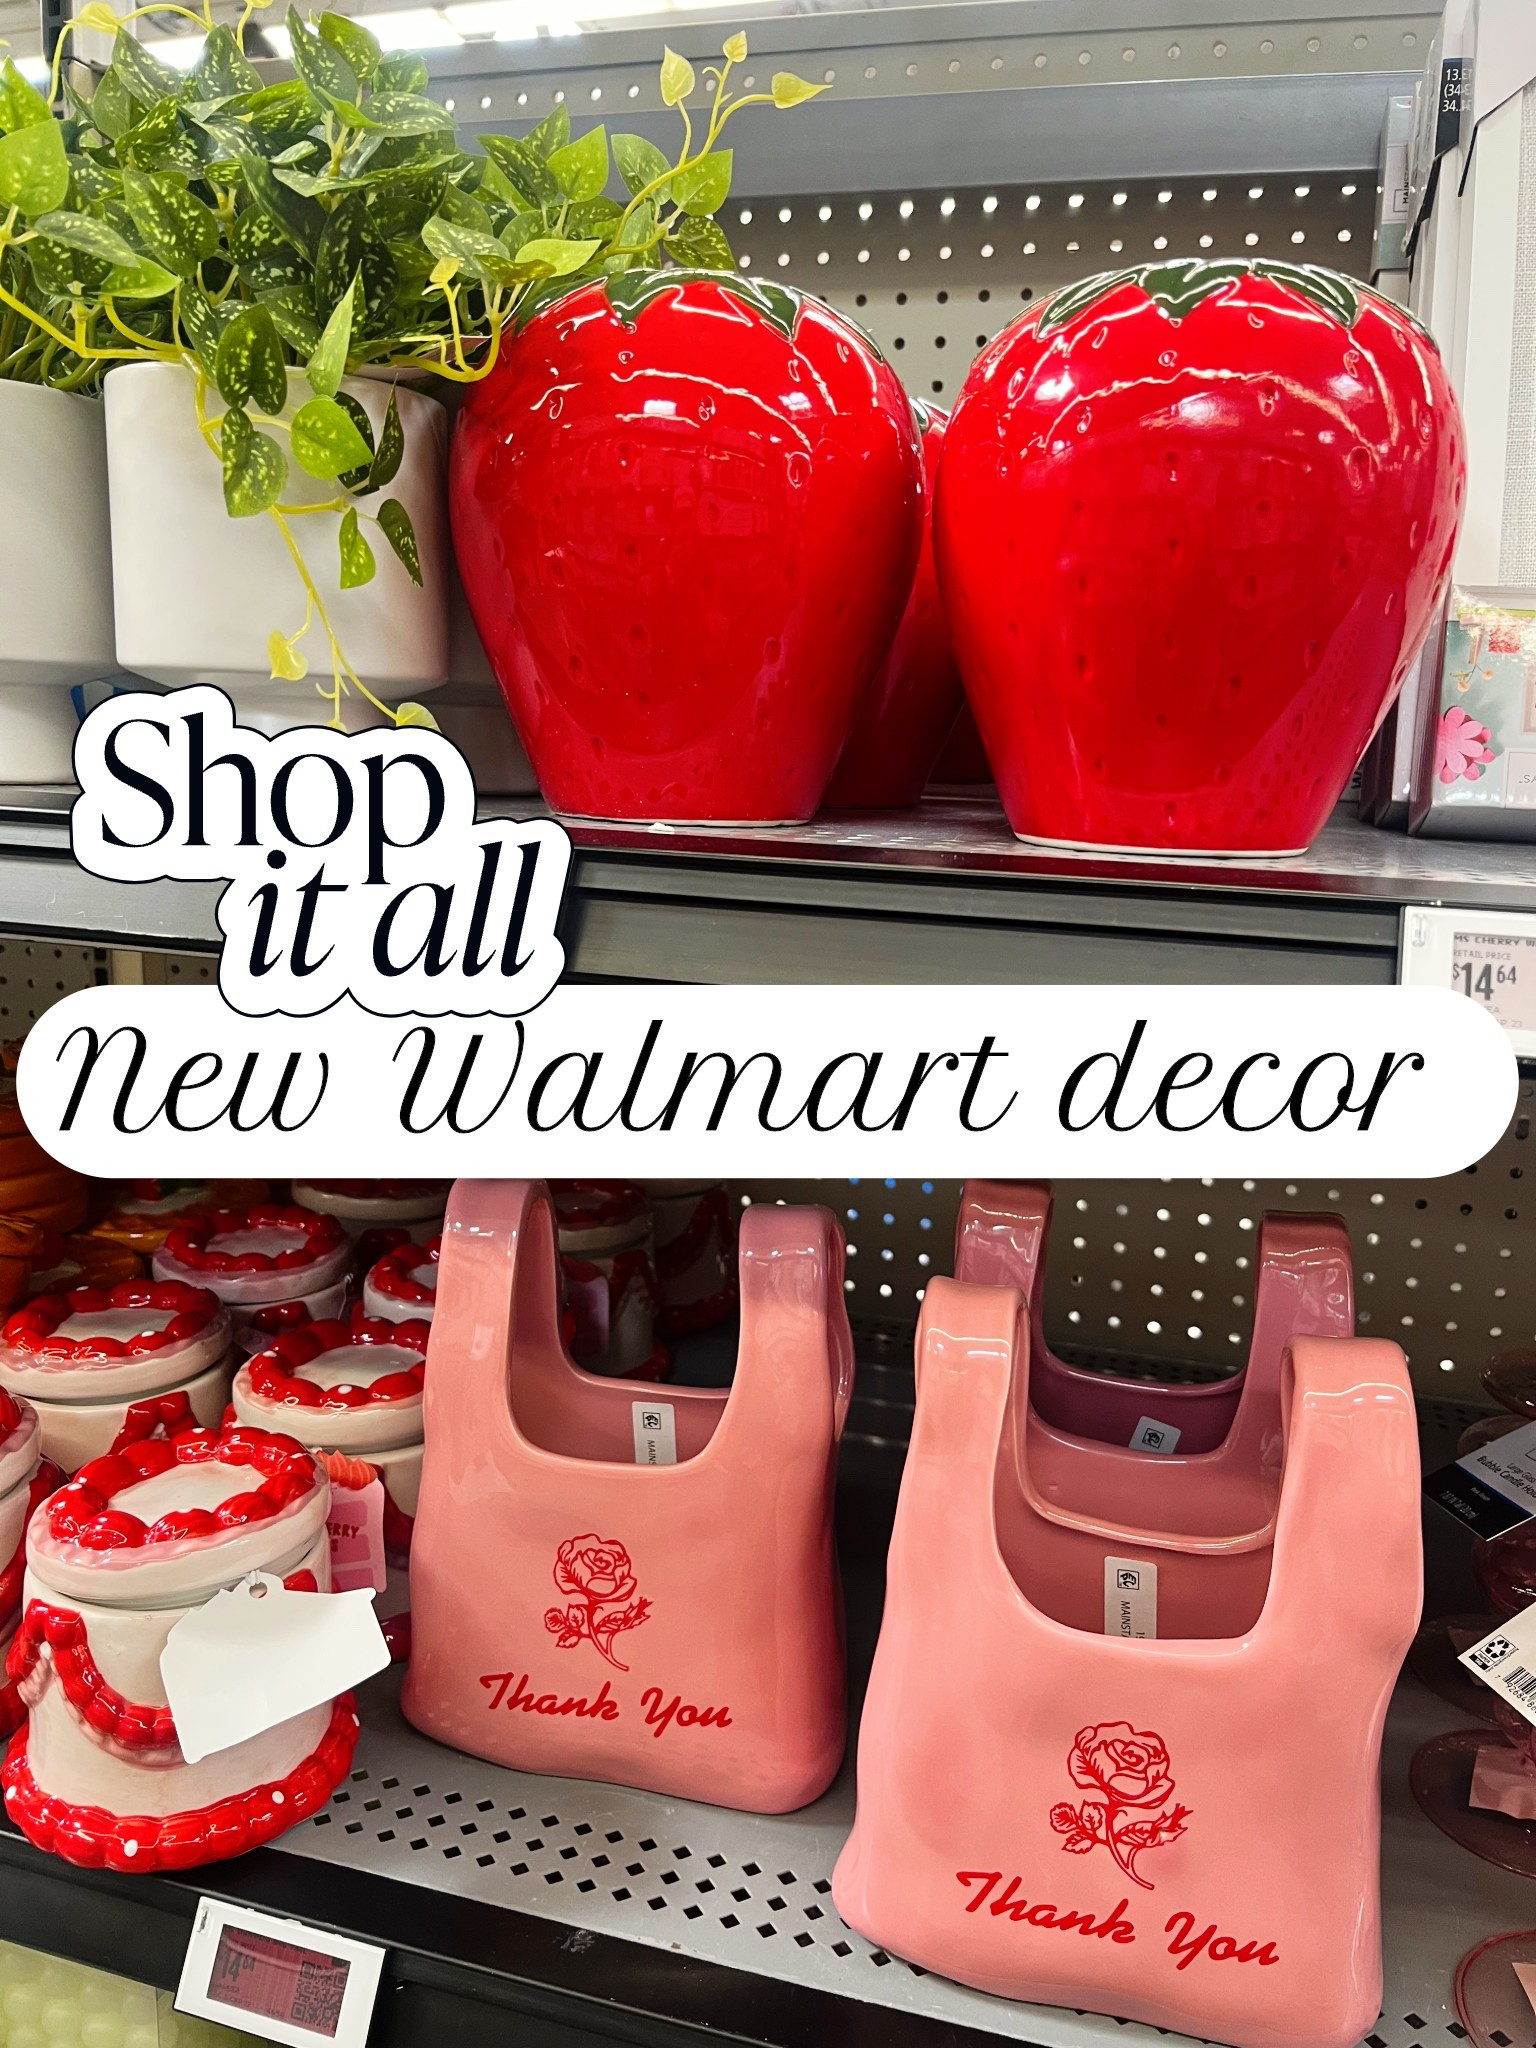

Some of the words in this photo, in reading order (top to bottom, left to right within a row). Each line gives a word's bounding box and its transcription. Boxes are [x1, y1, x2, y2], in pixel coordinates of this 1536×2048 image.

[1454, 950, 1484, 959] RETAIL
[1486, 951, 1511, 960] PRICE
[1475, 936, 1520, 946] CHERRY
[1526, 938, 1536, 948] W
[1476, 1456, 1502, 1474] Bubble
[1500, 1470, 1522, 1488] Candle
[478, 1671, 620, 1721] Thank
[640, 1687, 733, 1738] You
[956, 1871, 1136, 1945] Thank
[1164, 1911, 1281, 1971] You
